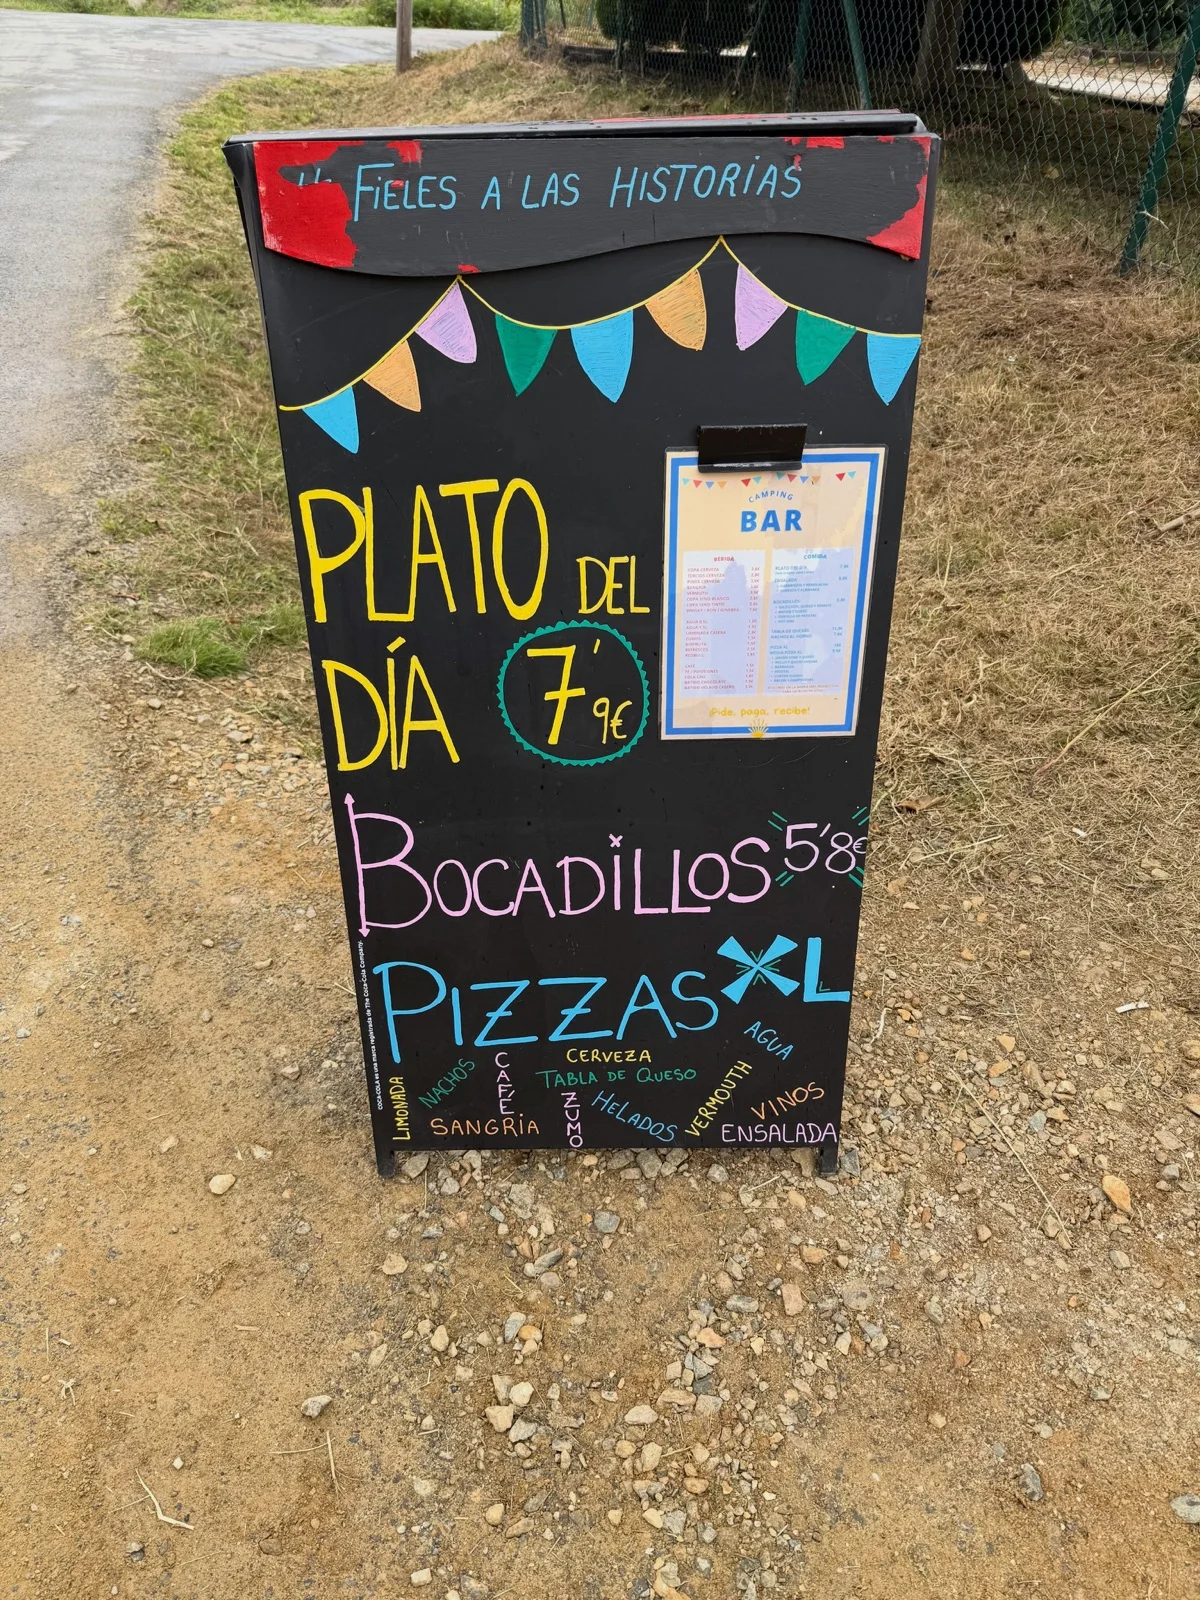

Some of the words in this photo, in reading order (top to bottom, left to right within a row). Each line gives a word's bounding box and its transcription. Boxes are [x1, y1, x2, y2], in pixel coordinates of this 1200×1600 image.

[481, 176, 501, 210] A
[521, 172, 581, 209] LAS
[748, 490, 794, 503] CAMPING
[740, 509, 803, 533] BAR
[298, 478, 549, 623] PLATO
[576, 555, 650, 615] DEL
[321, 636, 461, 772] DÍA
[360, 968, 369, 997] Coca-Cola
[371, 961, 720, 1064] PIZZAS
[716, 934, 851, 1005] XL
[365, 1009, 372, 1017] de
[366, 1017, 376, 1045] registrada
[566, 1048, 652, 1063] CERVEZA
[743, 1021, 794, 1061] AGUA
[418, 1058, 476, 1109] NACHOS
[494, 1051, 516, 1115] CAFÉ
[535, 1069, 598, 1089] TABLA
[607, 1069, 626, 1082] DE
[636, 1067, 697, 1083] QUESO
[389, 1076, 411, 1141] LIMONADA
[560, 1091, 584, 1148] ZUMO
[591, 1090, 679, 1142] HELADOS
[684, 1060, 753, 1139] VERMOUTH
[750, 1081, 825, 1120] VINOS
[722, 1122, 838, 1143] ENSALADA
